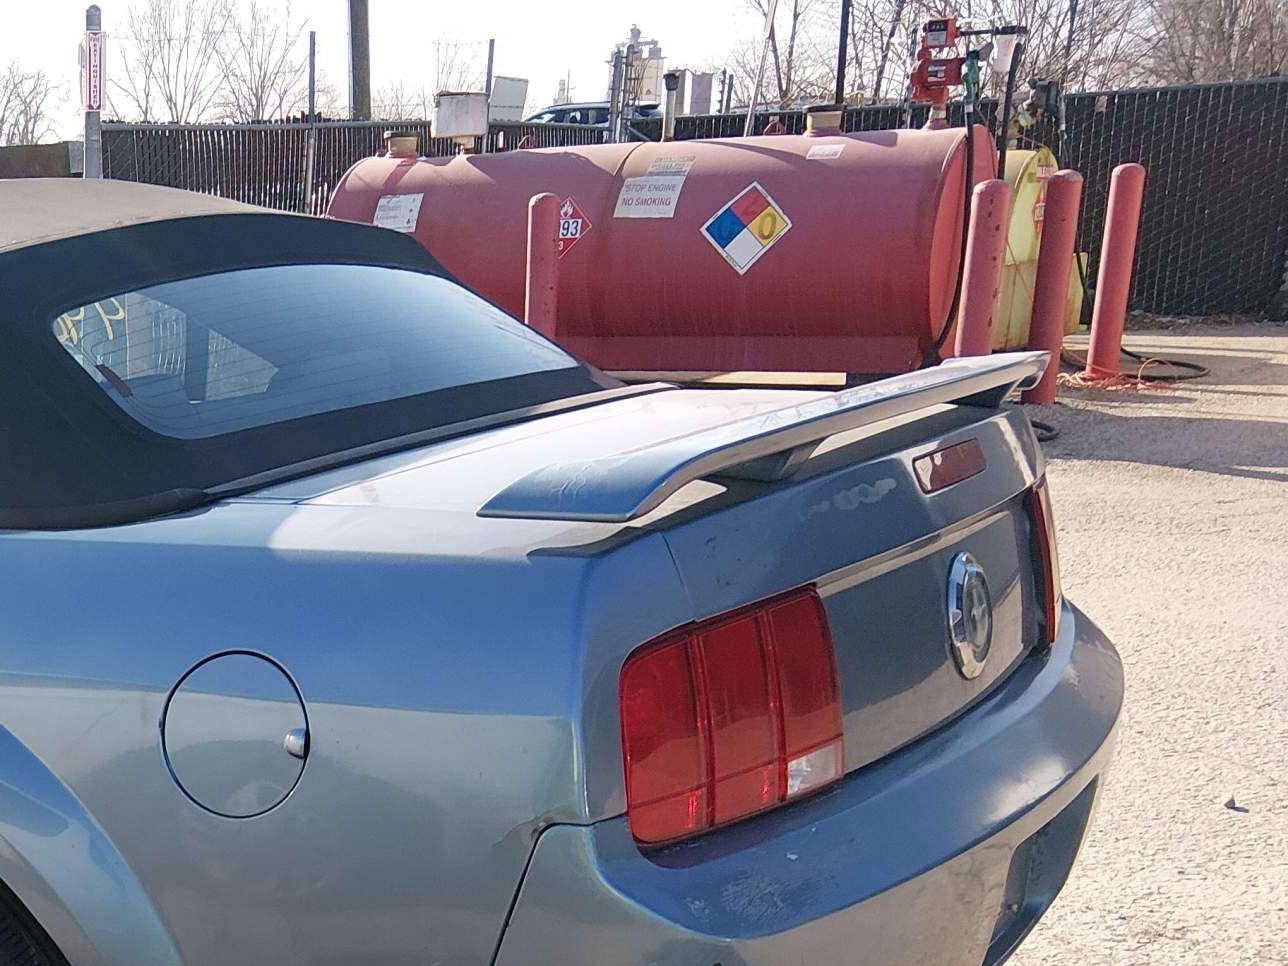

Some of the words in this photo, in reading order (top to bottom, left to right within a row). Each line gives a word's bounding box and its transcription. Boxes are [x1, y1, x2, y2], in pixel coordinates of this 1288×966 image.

[625, 184, 646, 192] STOP
[648, 184, 676, 192] ENGINE
[622, 198, 633, 206] NO
[635, 198, 671, 206] SMOKING
[562, 220, 579, 237] 93
[758, 212, 777, 240] 0
